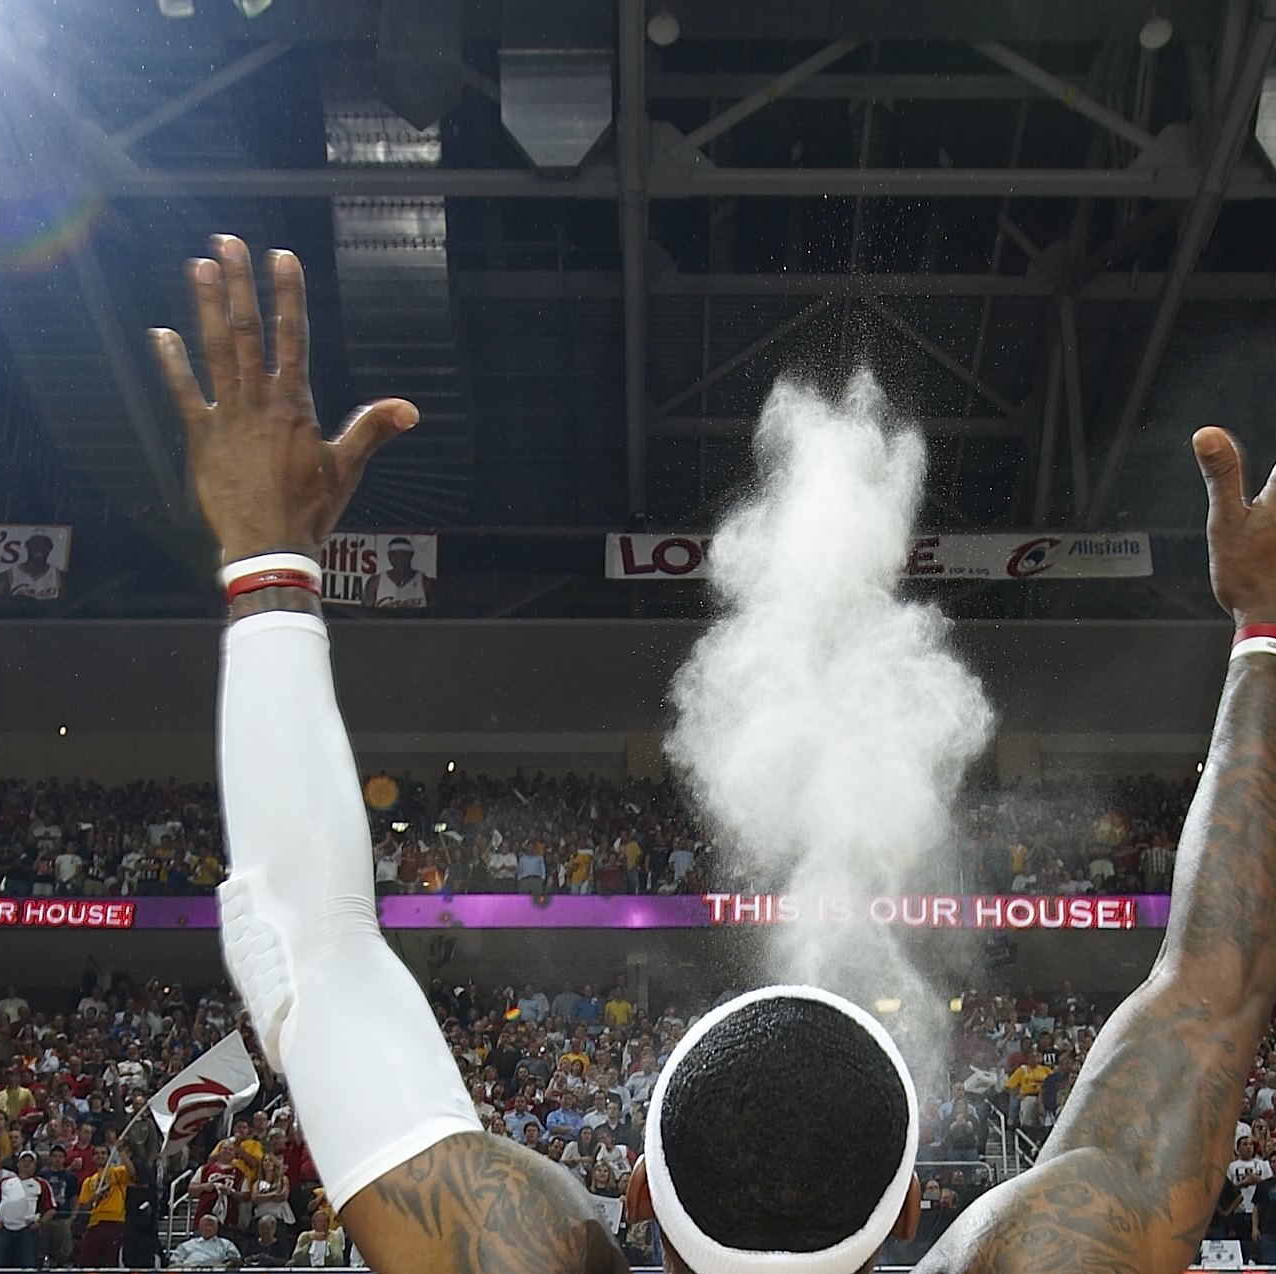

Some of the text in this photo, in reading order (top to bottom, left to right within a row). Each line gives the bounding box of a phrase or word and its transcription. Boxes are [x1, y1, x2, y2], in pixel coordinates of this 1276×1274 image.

[1069, 538, 1141, 556] Allstate
[24, 902, 133, 928] HOUSE!
[706, 893, 801, 922] THIS
[869, 897, 959, 926] OUR
[975, 898, 1134, 929] HOUSE!
